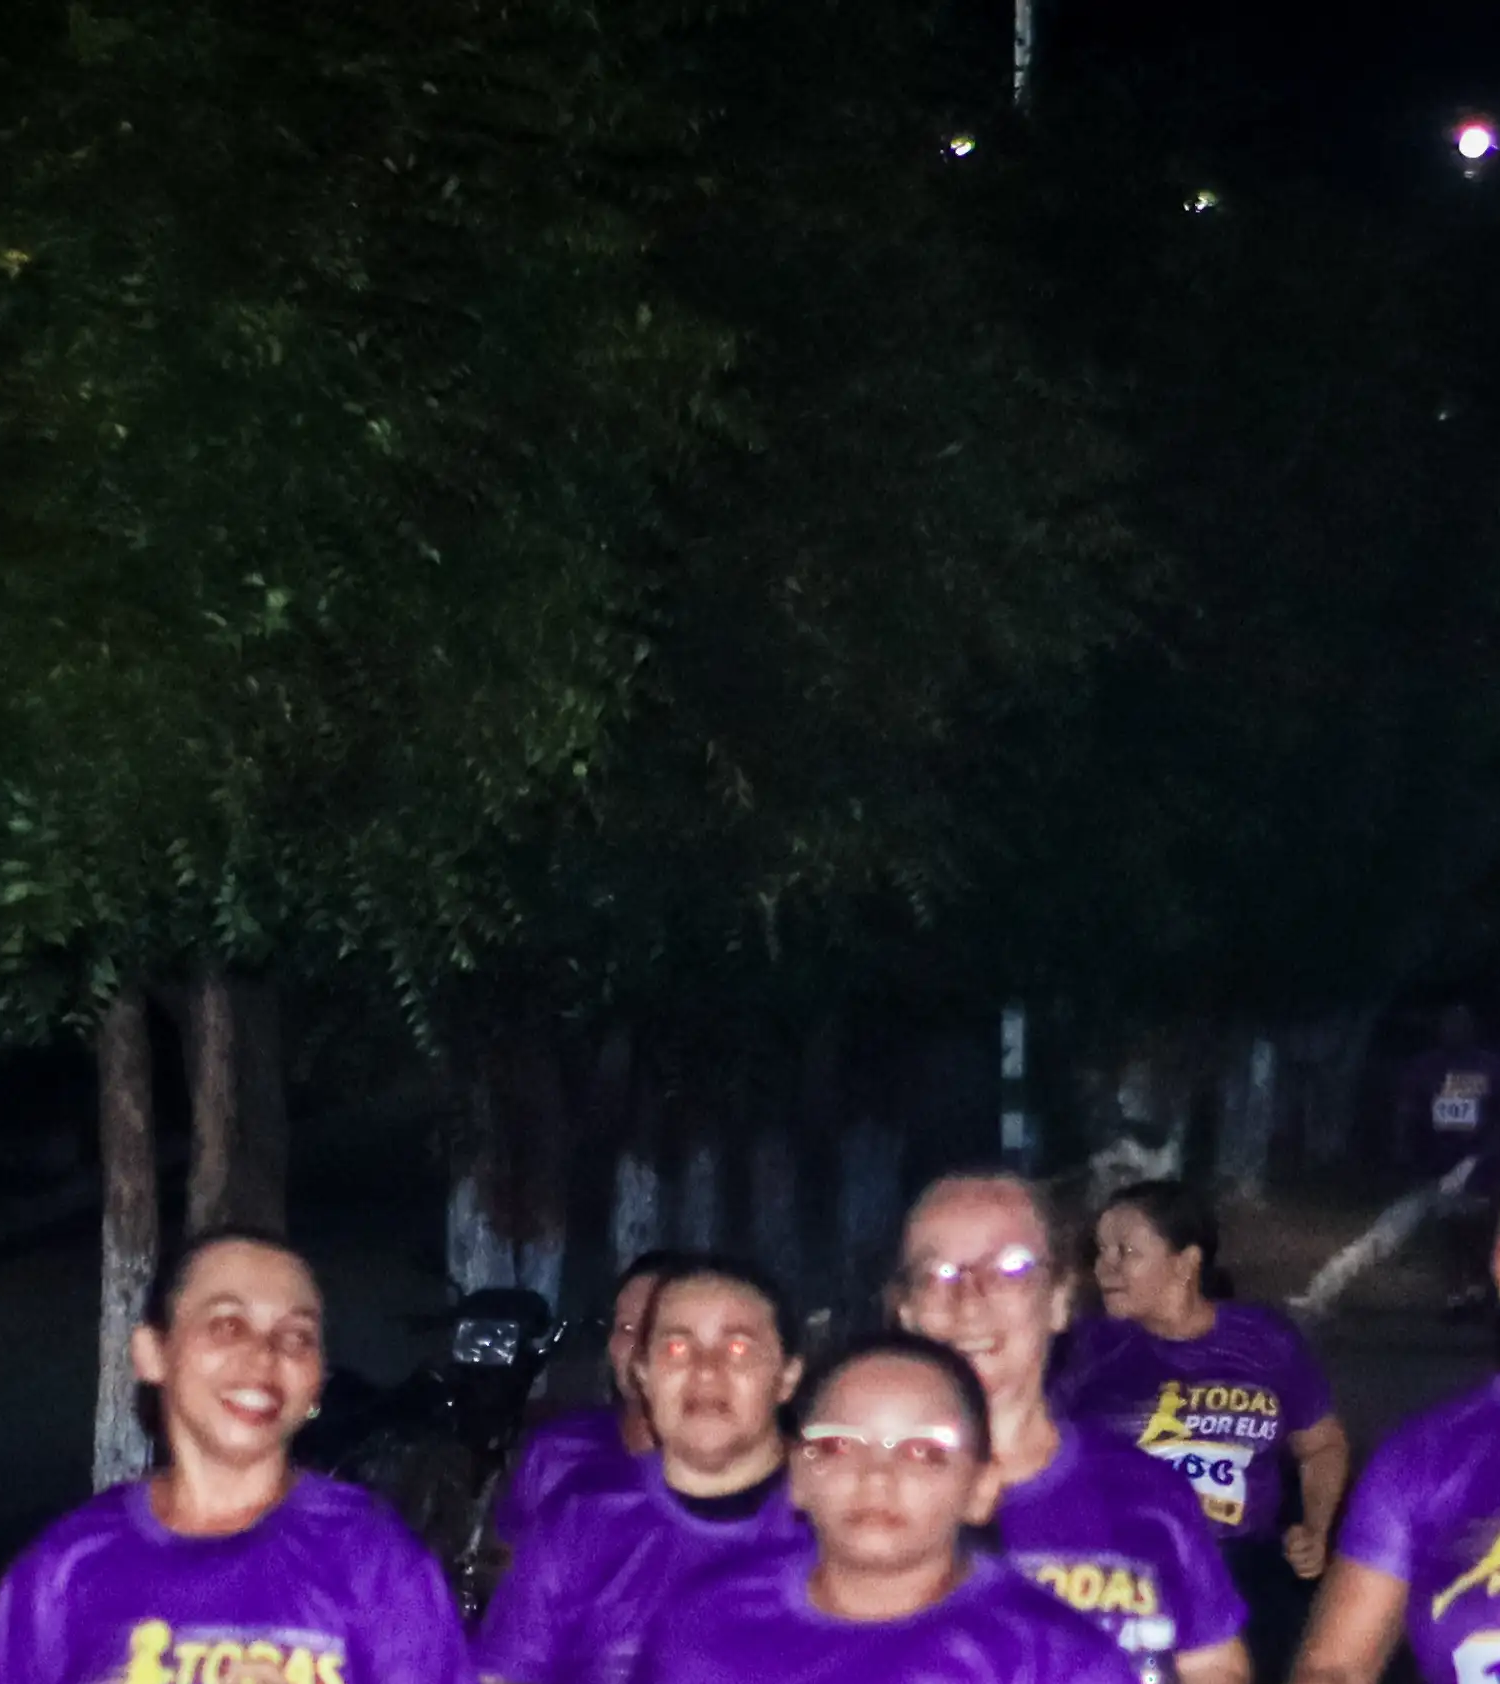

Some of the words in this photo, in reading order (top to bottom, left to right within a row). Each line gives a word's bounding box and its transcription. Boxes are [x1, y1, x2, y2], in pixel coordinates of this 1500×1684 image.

[1188, 1386, 1277, 1417] TODAS
[1185, 1415, 1232, 1434] POR
[1235, 1417, 1278, 1440] ELAS
